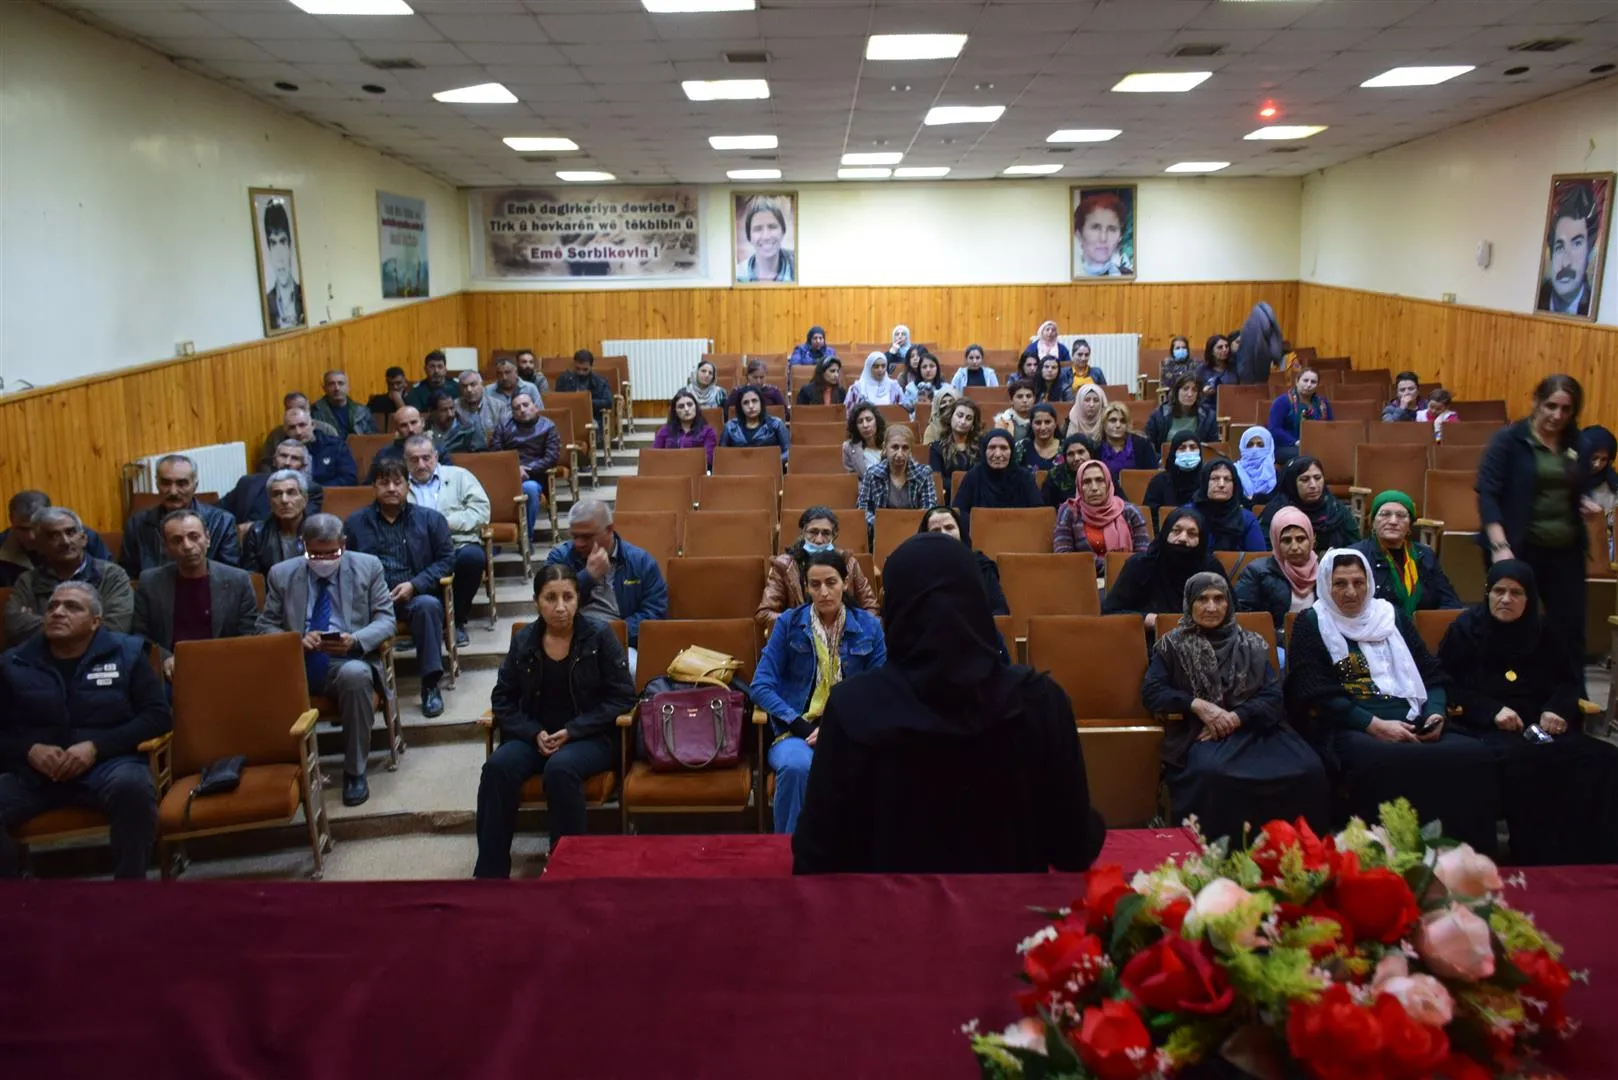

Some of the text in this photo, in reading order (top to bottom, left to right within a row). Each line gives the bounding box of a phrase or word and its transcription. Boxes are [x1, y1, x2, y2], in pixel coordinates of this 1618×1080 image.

[507, 202, 536, 214] Emê
[490, 221, 515, 231] Tirk
[530, 246, 563, 259] Emê
